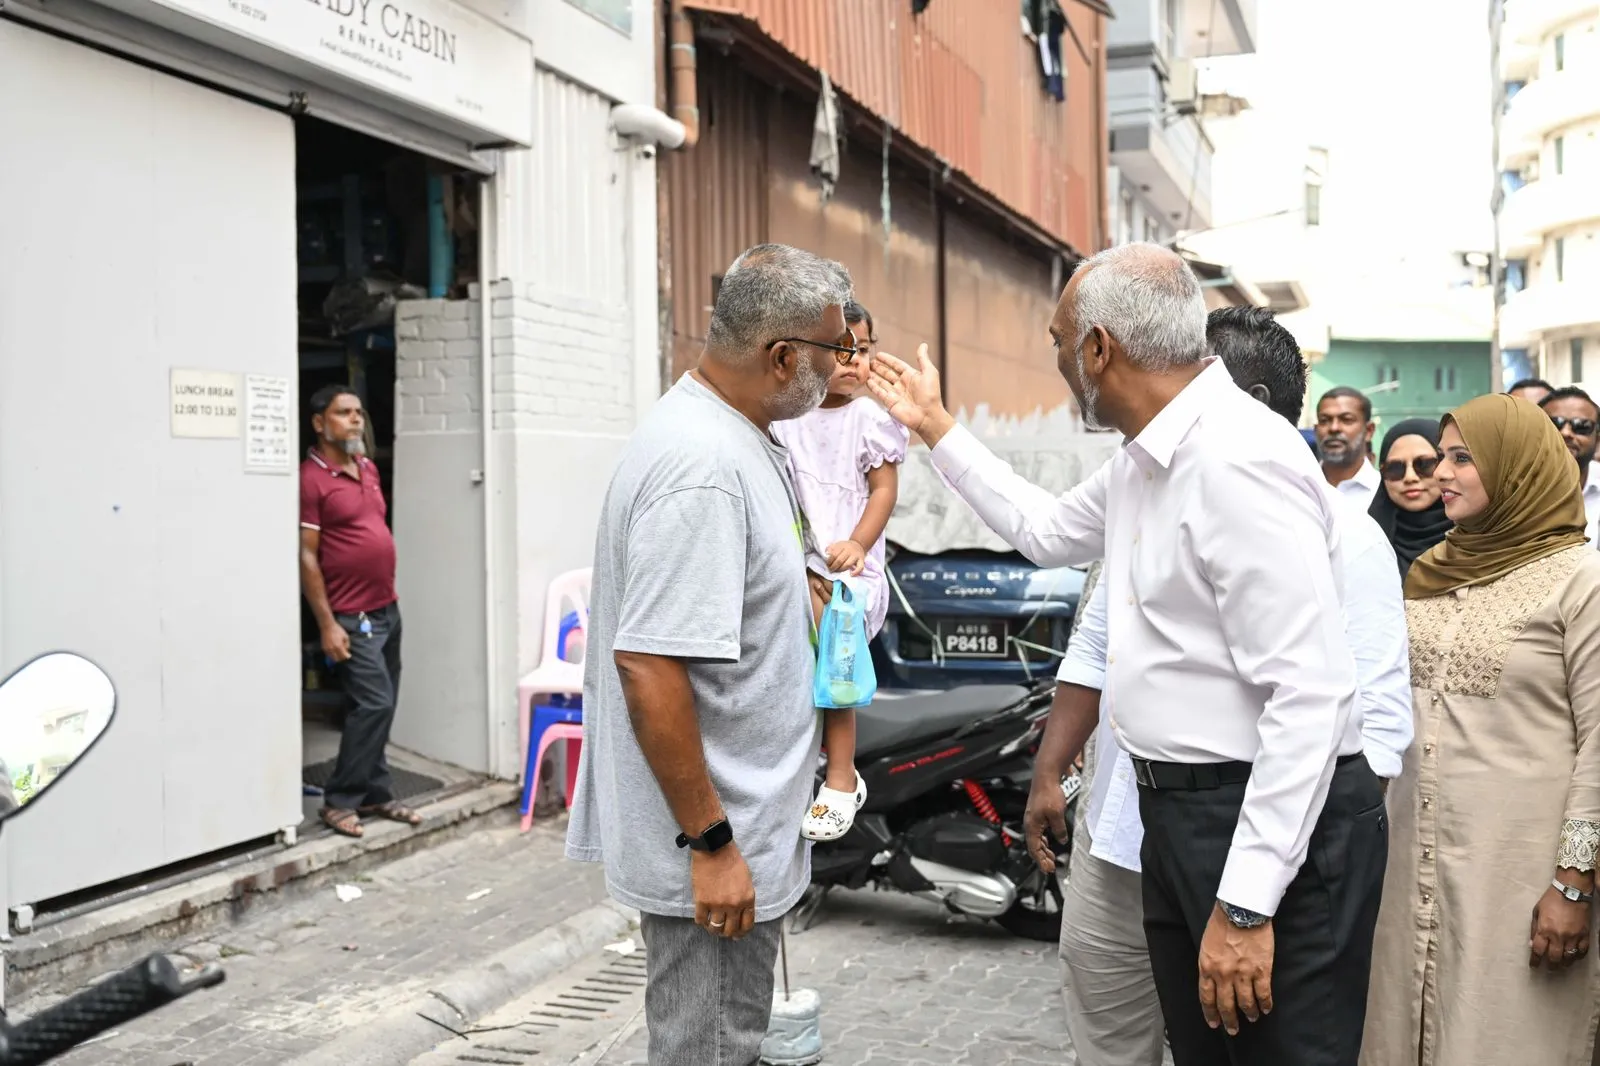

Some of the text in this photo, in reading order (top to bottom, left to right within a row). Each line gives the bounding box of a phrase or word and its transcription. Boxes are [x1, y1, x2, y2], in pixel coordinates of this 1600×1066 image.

[381, 4, 457, 64] CABIN
[338, 24, 403, 61] RENTALS
[175, 384, 205, 396] LUNCH
[200, 405, 212, 416] TO
[946, 635, 998, 651] P8418
